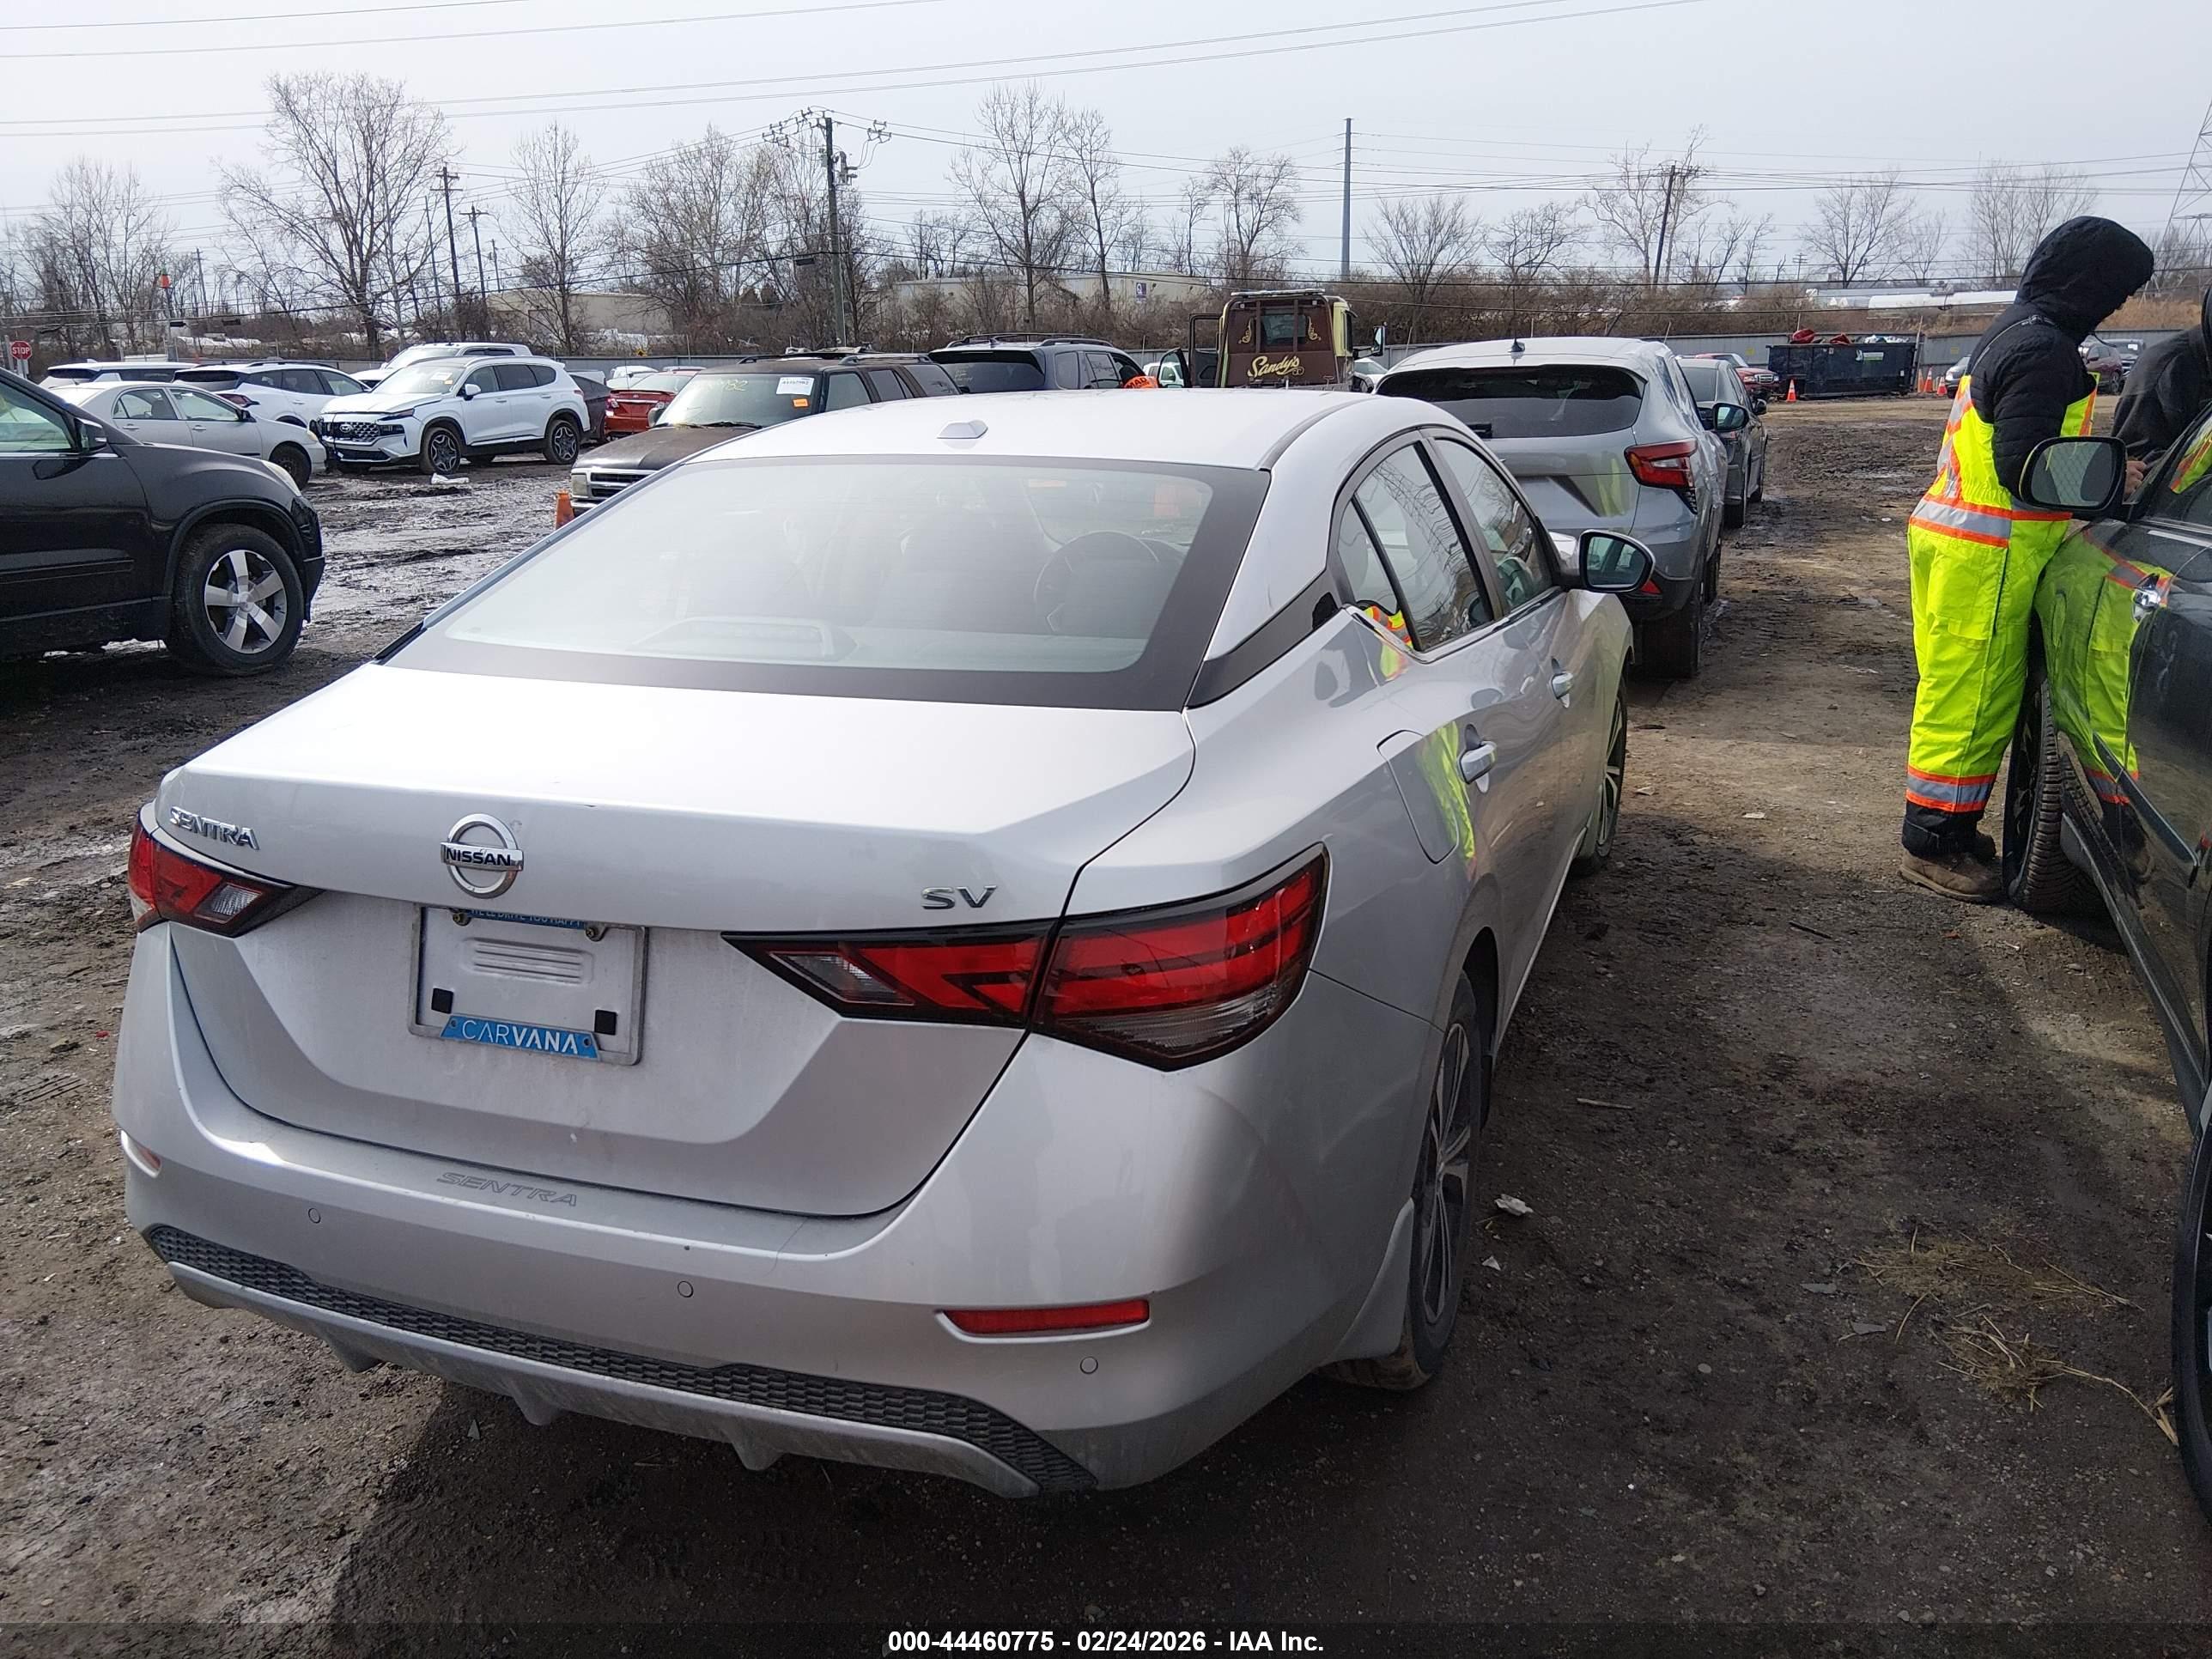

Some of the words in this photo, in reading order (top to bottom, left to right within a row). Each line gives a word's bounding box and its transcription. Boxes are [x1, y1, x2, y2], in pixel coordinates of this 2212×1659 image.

[1248, 356, 1301, 377] Sandy's
[169, 805, 260, 850] SENTRA
[446, 848, 511, 866] NISSAN
[921, 884, 997, 909] SV
[462, 1020, 578, 1054] CARVANA
[436, 1171, 577, 1206] SENTRA
